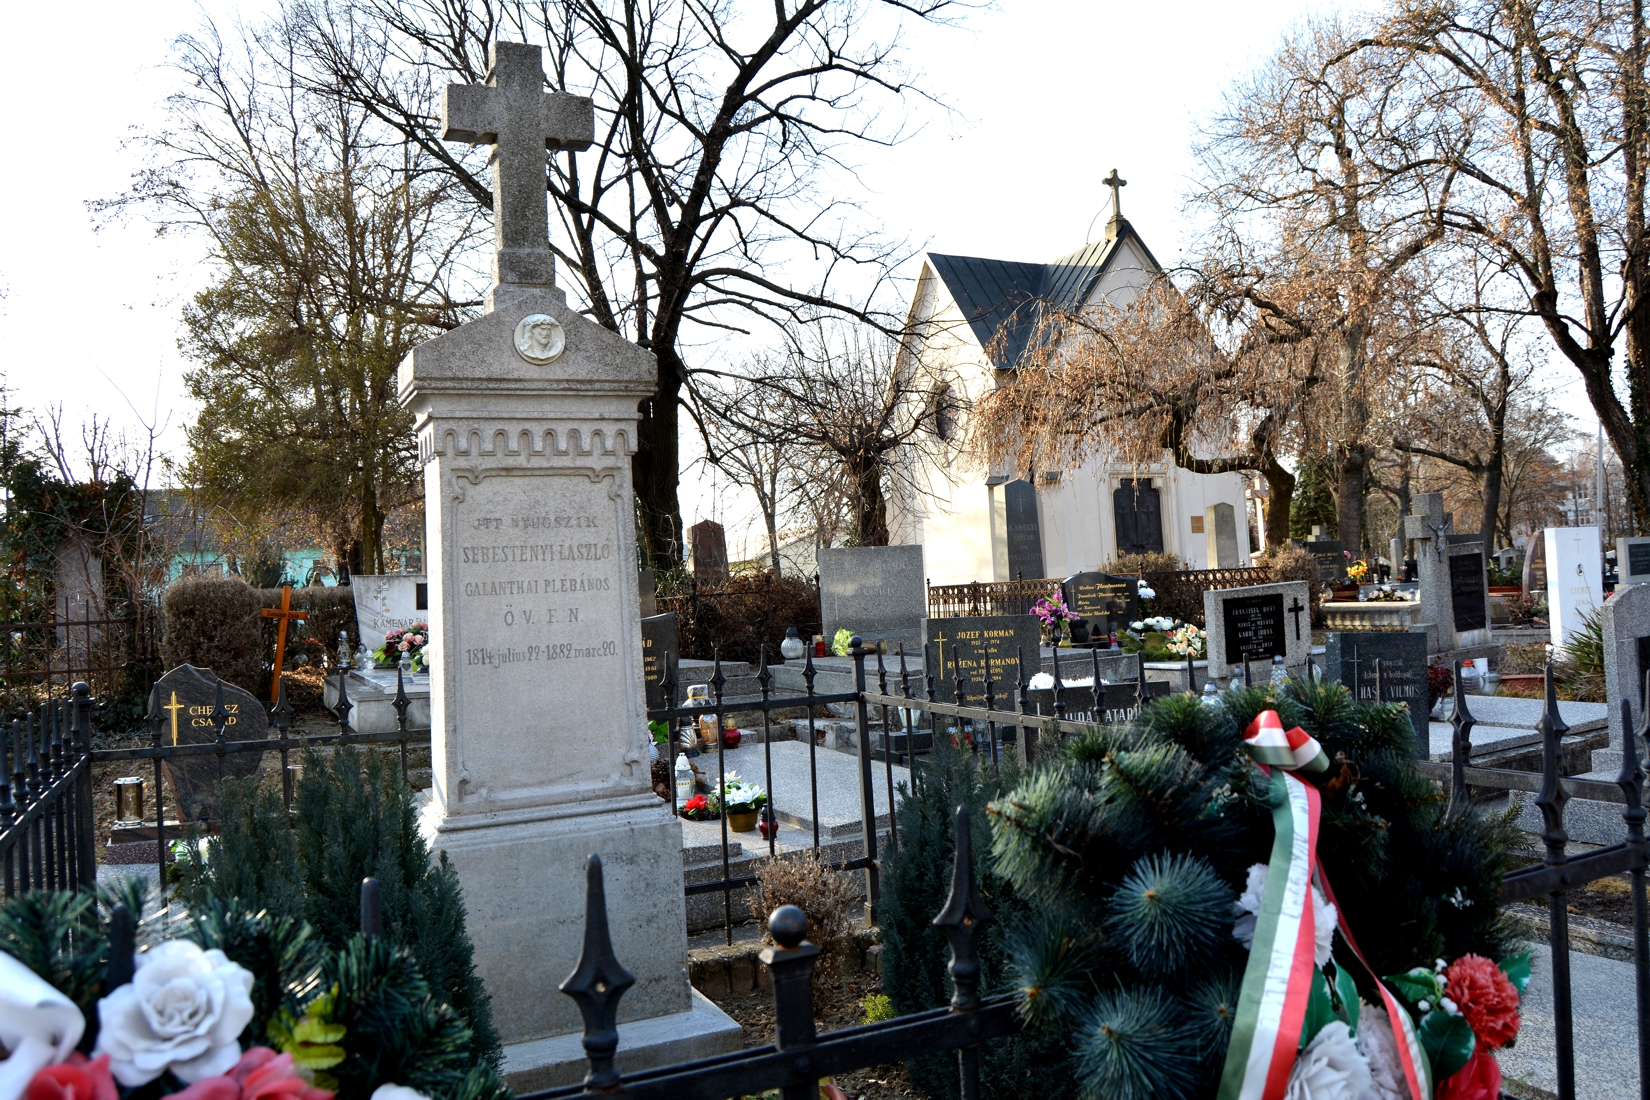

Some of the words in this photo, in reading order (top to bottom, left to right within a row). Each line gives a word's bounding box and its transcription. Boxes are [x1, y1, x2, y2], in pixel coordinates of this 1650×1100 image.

[511, 516, 599, 529] NYUGSZIK
[465, 579, 539, 596] GALANTHAI
[544, 573, 611, 593] PLÉBÁNOS
[522, 610, 535, 624] V.
[568, 607, 583, 623] N.
[373, 616, 414, 629] KAMENÁR
[983, 629, 1014, 638] KORMAN
[189, 704, 239, 716] CHEEZ
